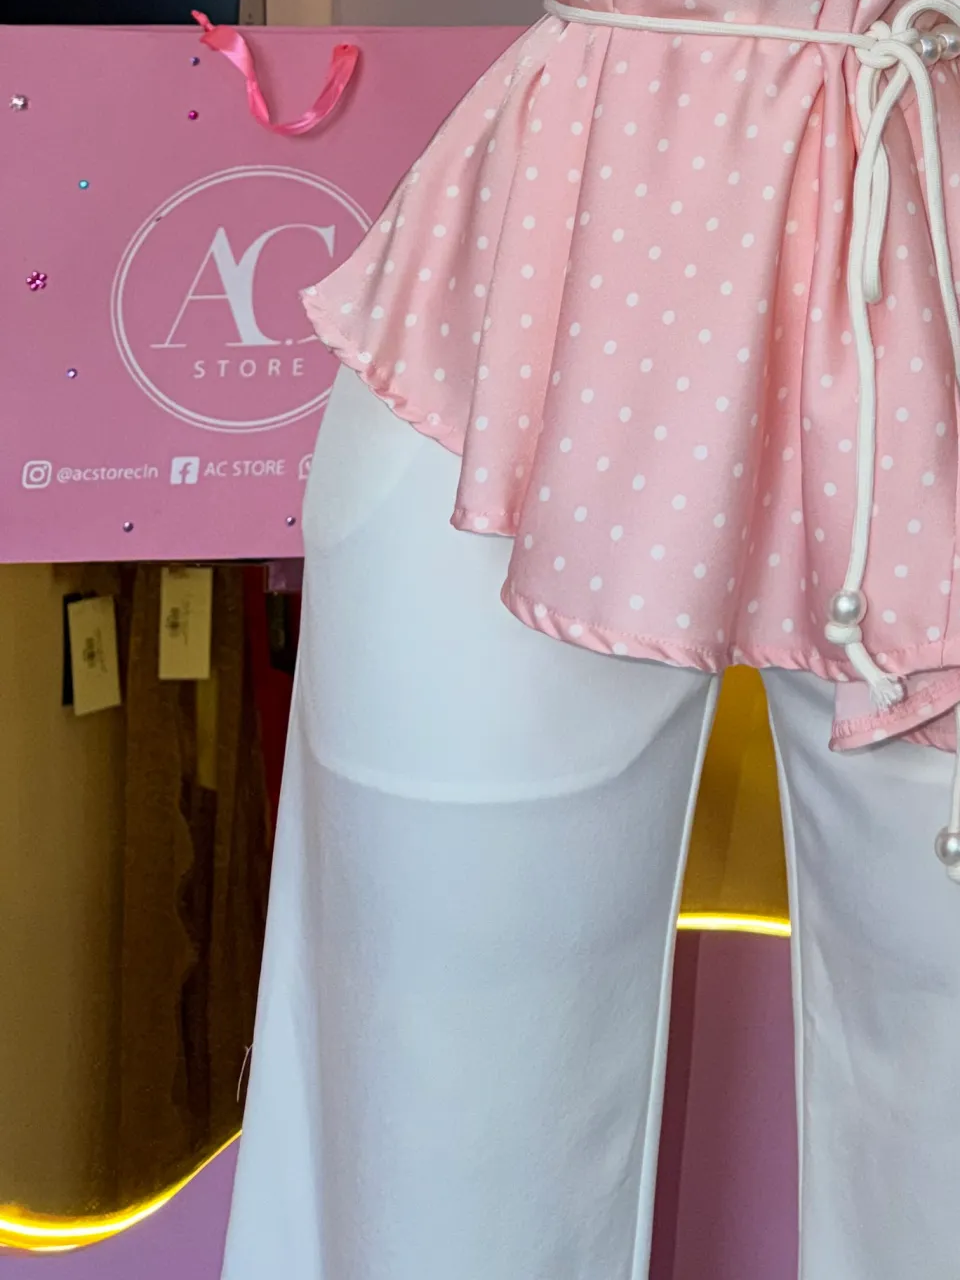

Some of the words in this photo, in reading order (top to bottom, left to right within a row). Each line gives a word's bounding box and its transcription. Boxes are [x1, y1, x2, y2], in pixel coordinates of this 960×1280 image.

[193, 357, 305, 379] STORE
[203, 461, 228, 477] AC
[232, 459, 286, 477] STORE
